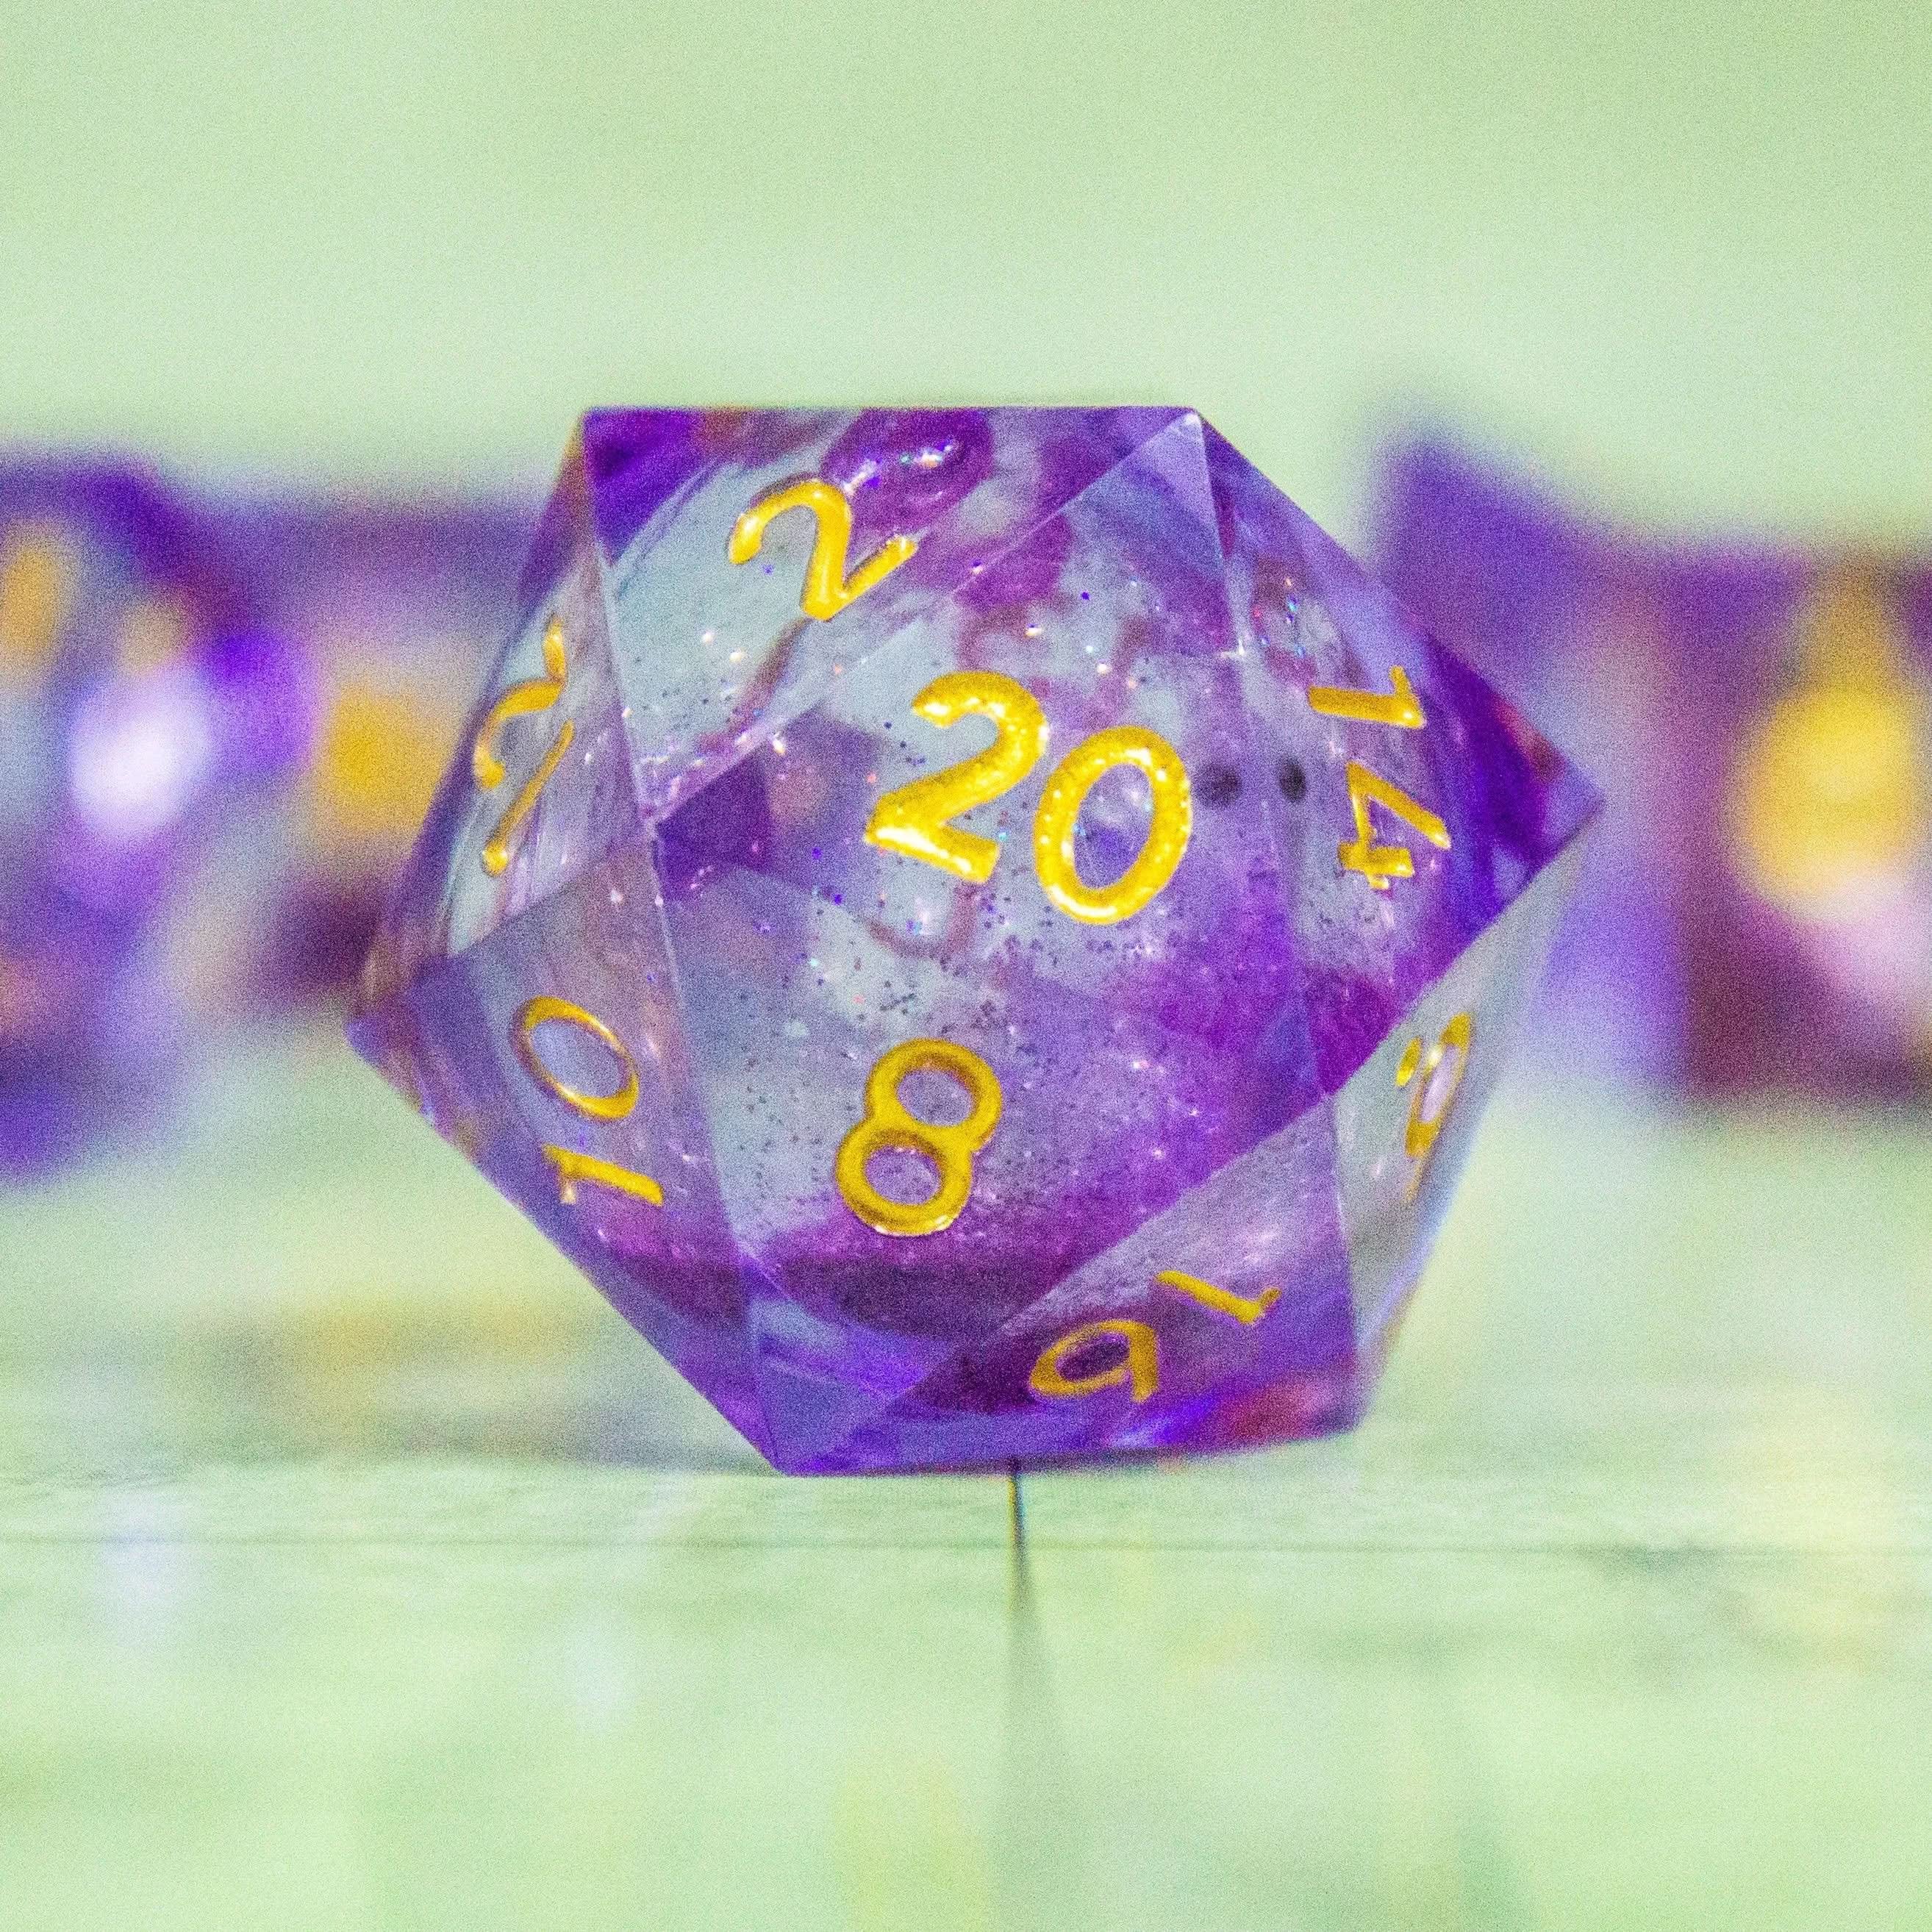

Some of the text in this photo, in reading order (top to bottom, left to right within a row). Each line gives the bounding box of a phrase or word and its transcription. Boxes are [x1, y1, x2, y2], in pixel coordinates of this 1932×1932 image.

[729, 479, 916, 620] 2
[865, 670, 1192, 925] 20
[1307, 665, 1451, 890] 14
[511, 995, 665, 1206] 10
[834, 1038, 1003, 1237] 8
[1029, 1270, 1281, 1403] 16
